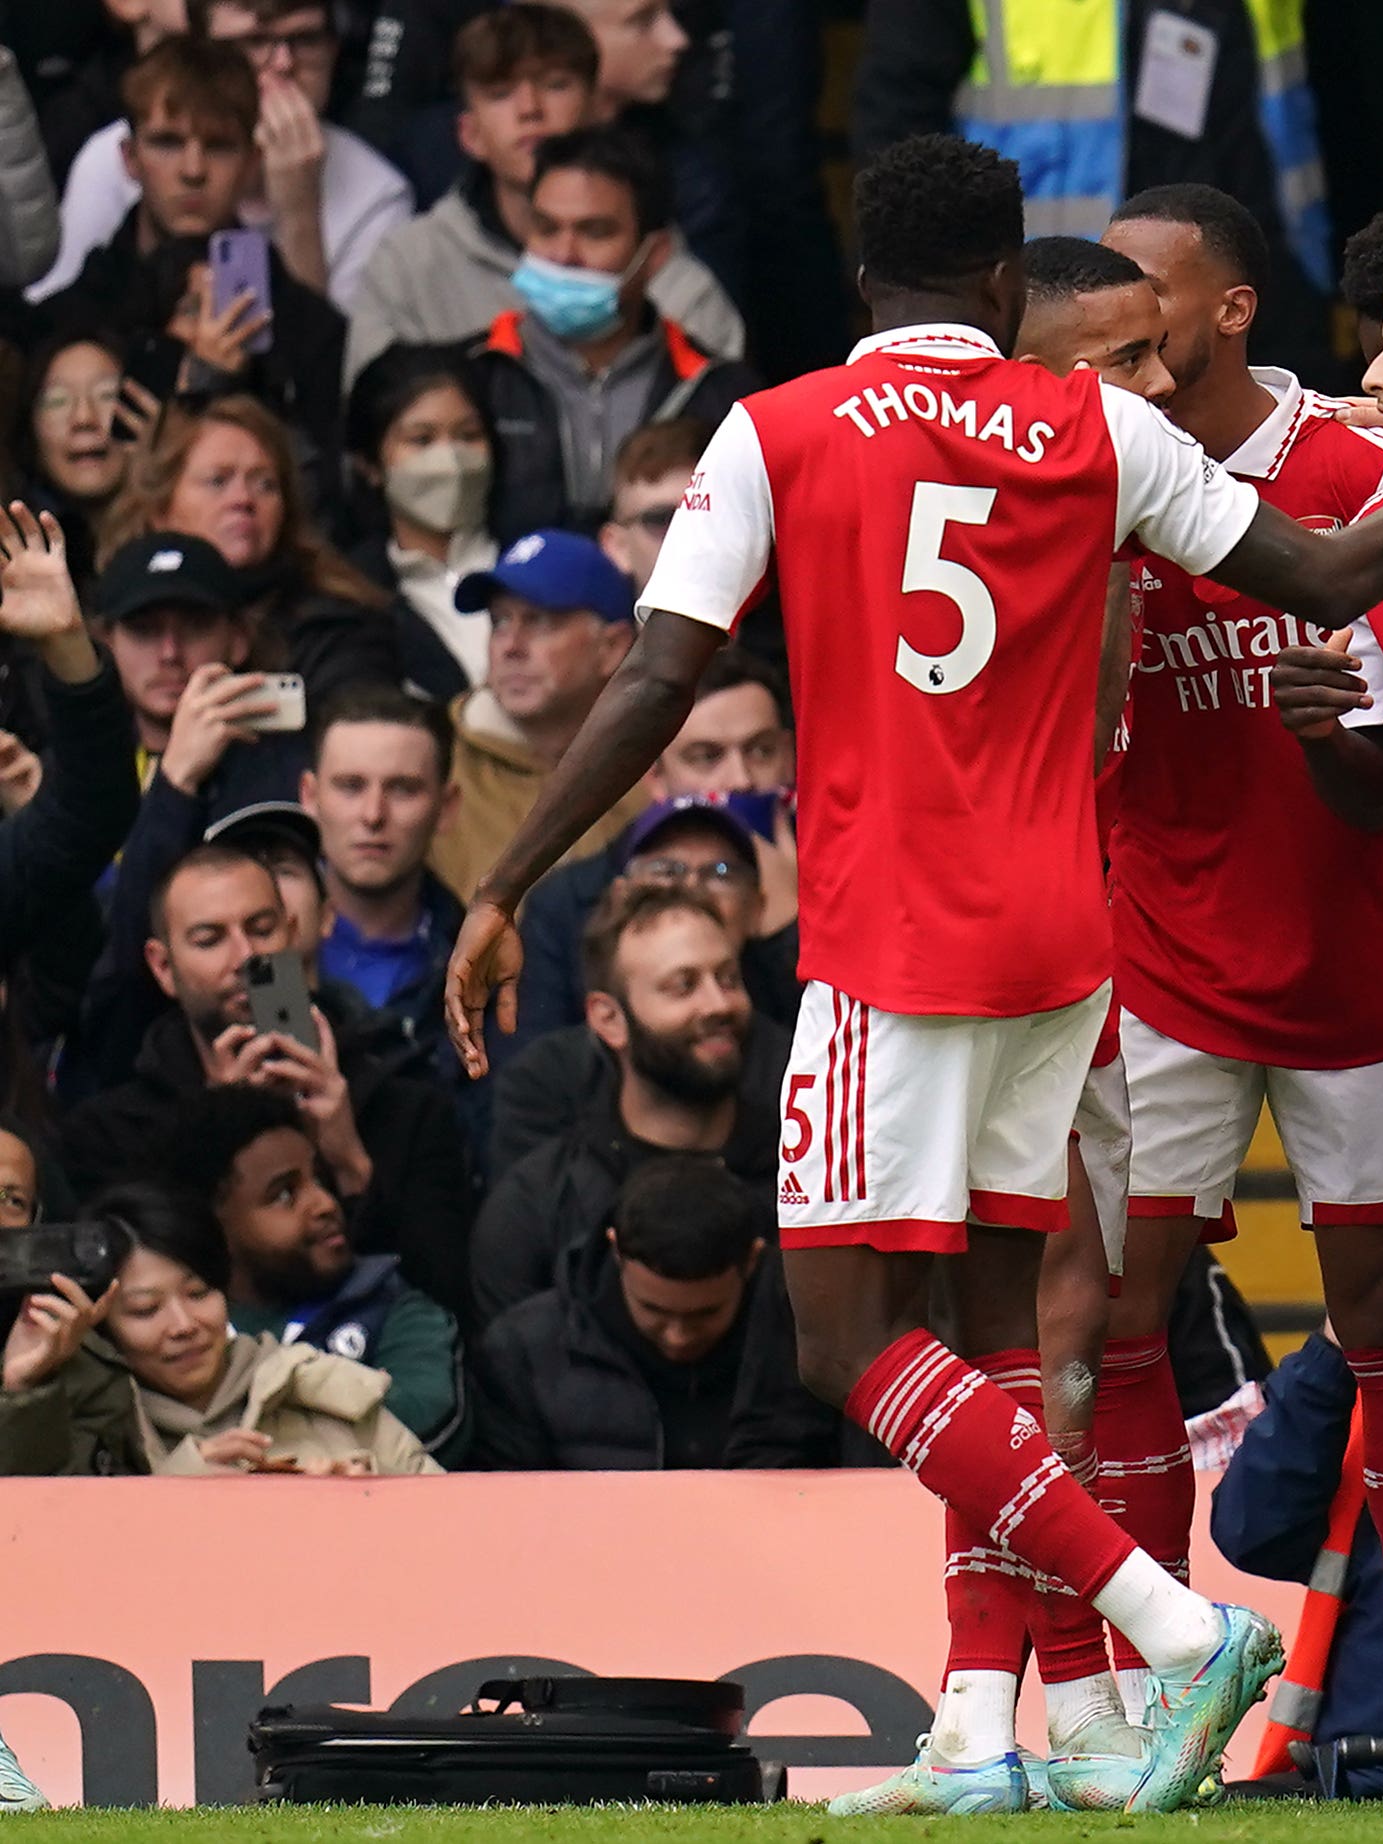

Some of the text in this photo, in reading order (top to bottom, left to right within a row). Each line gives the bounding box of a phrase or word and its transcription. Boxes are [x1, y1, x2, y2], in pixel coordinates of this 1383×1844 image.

[833, 382, 1055, 464] THOMAS
[894, 480, 998, 694] 5
[1175, 669, 1221, 712] FLY
[781, 1074, 816, 1163] 5
